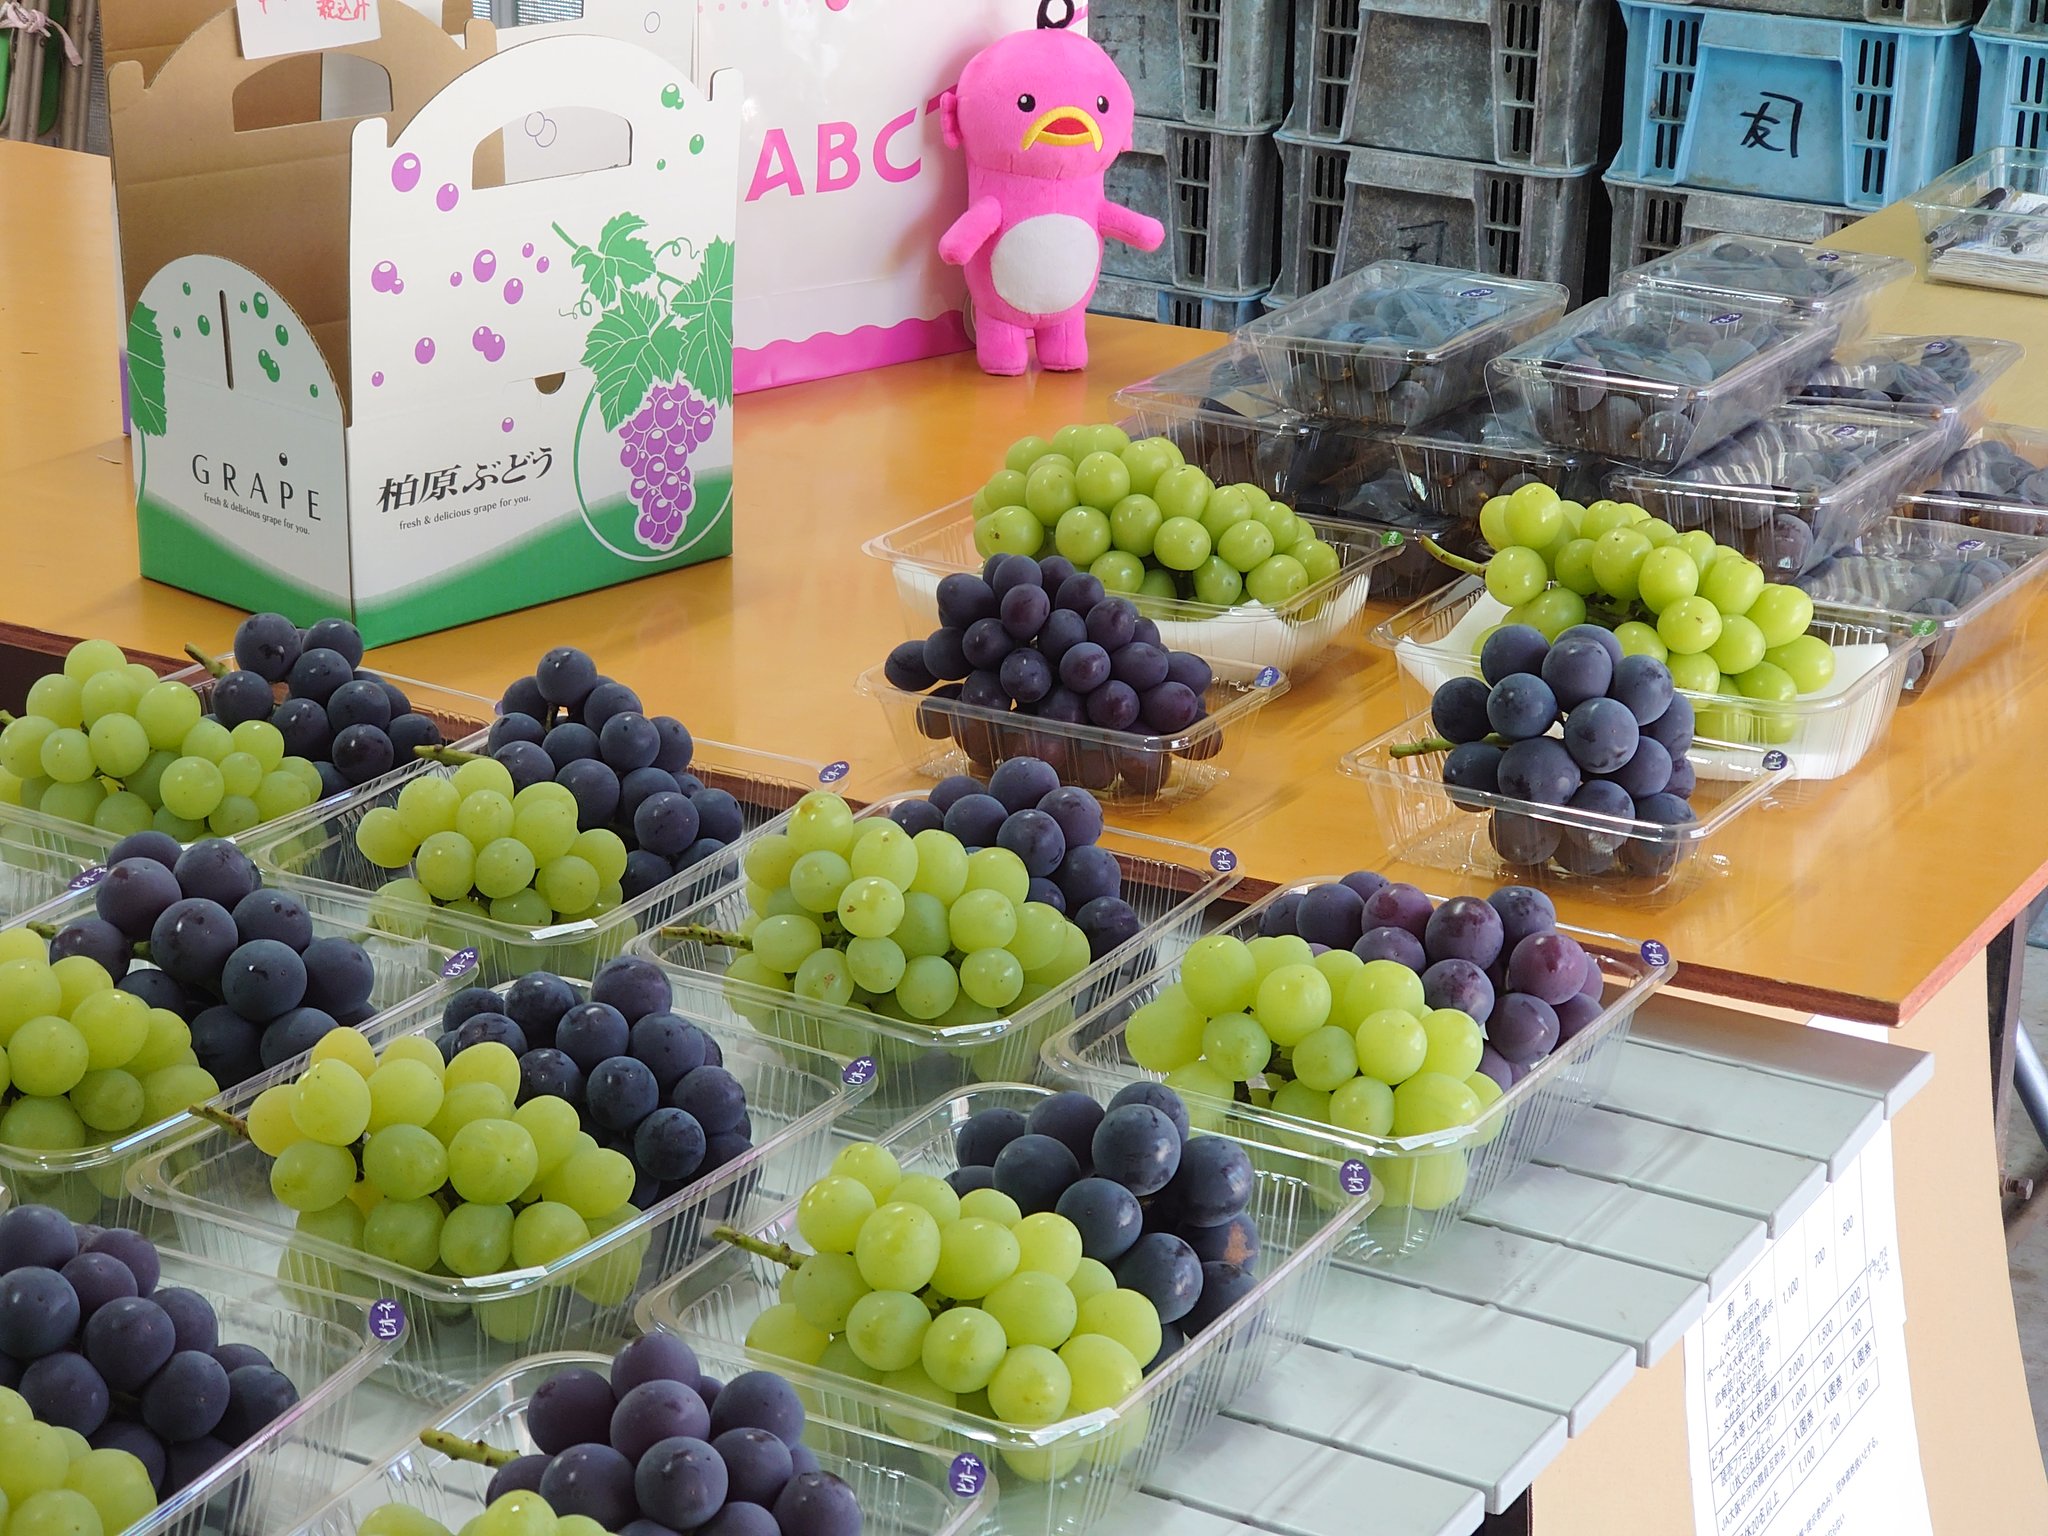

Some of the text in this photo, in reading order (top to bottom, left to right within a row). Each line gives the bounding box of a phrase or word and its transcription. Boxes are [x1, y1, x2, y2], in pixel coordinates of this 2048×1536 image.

[192, 454, 321, 521] GRAPE
[376, 447, 552, 513] 柏原ぶどう
[204, 493, 311, 536] fresh & delicious grape for you.
[399, 496, 531, 530] fresh & delicious grape for you.
[1841, 1213, 1853, 1237] 500
[1813, 1244, 1826, 1270] 700
[1781, 1275, 1799, 1307] 1,100
[1844, 1283, 1861, 1316] 1,000
[1816, 1316, 1833, 1349] 1,500
[1850, 1315, 1862, 1342] 700
[1787, 1349, 1805, 1384] 2,000
[1821, 1348, 1834, 1376] 700
[1850, 1335, 1871, 1378] 入園券
[1790, 1380, 1807, 1414] 1,000
[1821, 1370, 1843, 1412] 入園券
[1857, 1375, 1869, 1403] 500
[1792, 1405, 1814, 1448] 入園券
[1829, 1410, 1841, 1438] 700
[1797, 1442, 1815, 1478] 1,100
